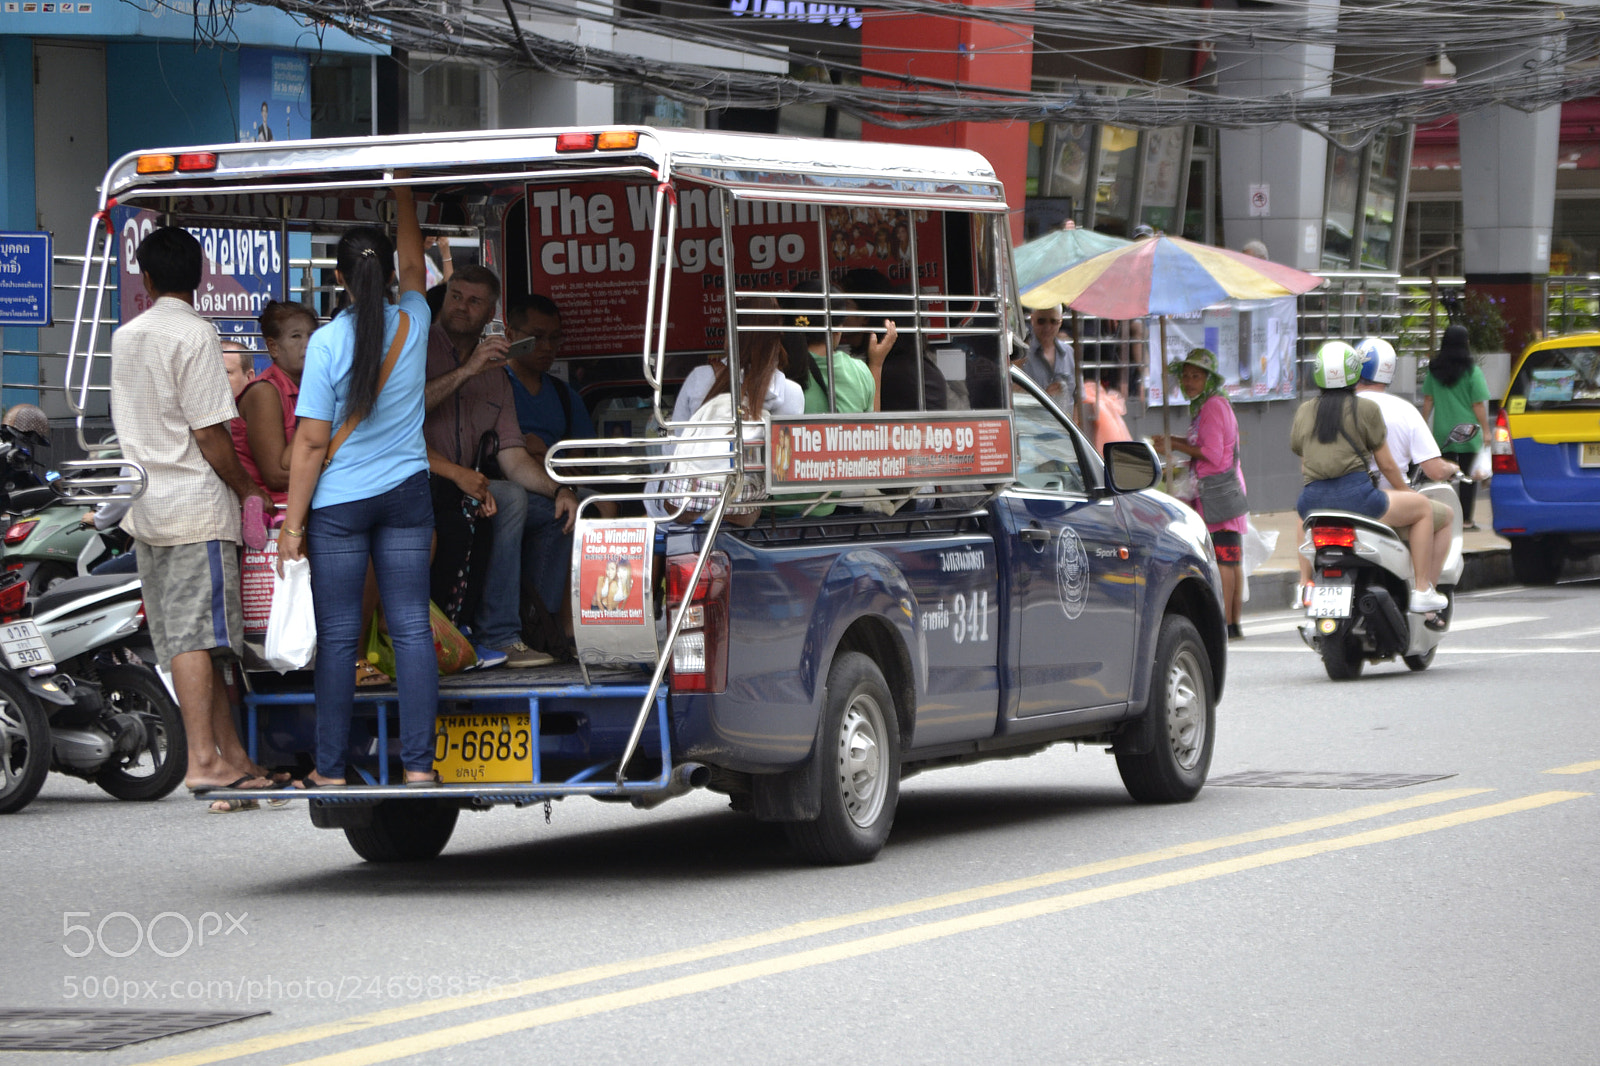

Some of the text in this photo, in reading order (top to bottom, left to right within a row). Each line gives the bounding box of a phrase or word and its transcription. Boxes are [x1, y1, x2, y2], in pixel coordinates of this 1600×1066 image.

[533, 187, 615, 236] The
[541, 237, 636, 275] Club
[749, 232, 805, 270] go
[702, 271, 783, 290] Pataya's
[792, 427, 822, 452] The
[825, 425, 889, 451] Windmill
[892, 425, 922, 450] Club
[925, 425, 952, 452] Ago
[956, 427, 974, 452] go
[794, 459, 835, 482] Pattaya's
[837, 457, 881, 479] Friendliest
[882, 457, 906, 477] Girls!!
[585, 529, 645, 544] The Windmill
[586, 545, 642, 555] Club Ago go
[1096, 547, 1118, 559] Spark
[246, 555, 266, 564] Club
[953, 591, 989, 644] 341
[1314, 608, 1343, 617] 1341
[18, 649, 42, 663] 930
[440, 717, 509, 728] THAILAND
